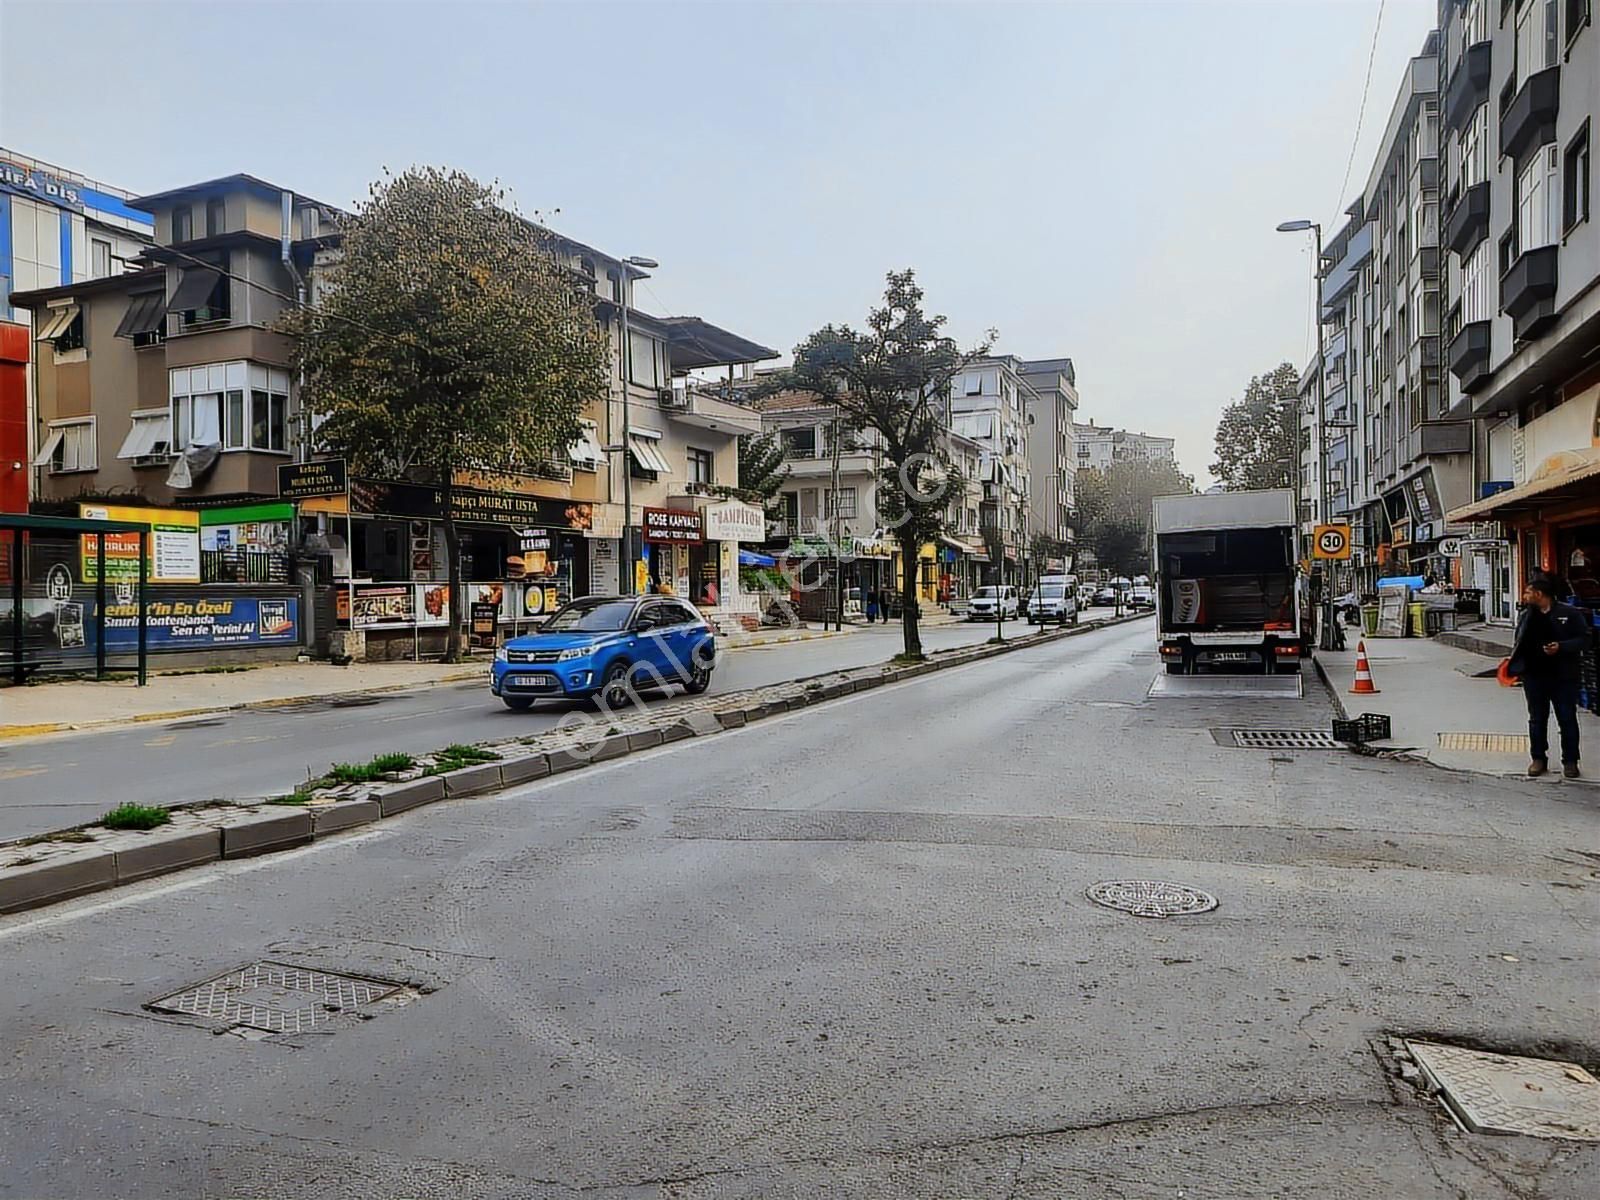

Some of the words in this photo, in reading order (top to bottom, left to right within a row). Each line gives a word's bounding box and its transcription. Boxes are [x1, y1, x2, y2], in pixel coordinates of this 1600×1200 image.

[479, 496, 512, 510] MURAT
[515, 500, 538, 512] USTA
[648, 512, 668, 526] ROSE
[1324, 535, 1341, 548] 30
[172, 602, 193, 615] En
[195, 600, 233, 615] Özeli
[171, 625, 192, 636] Sen
[194, 624, 208, 635] de
[211, 623, 241, 634] Yerini
[242, 622, 255, 633] Al
